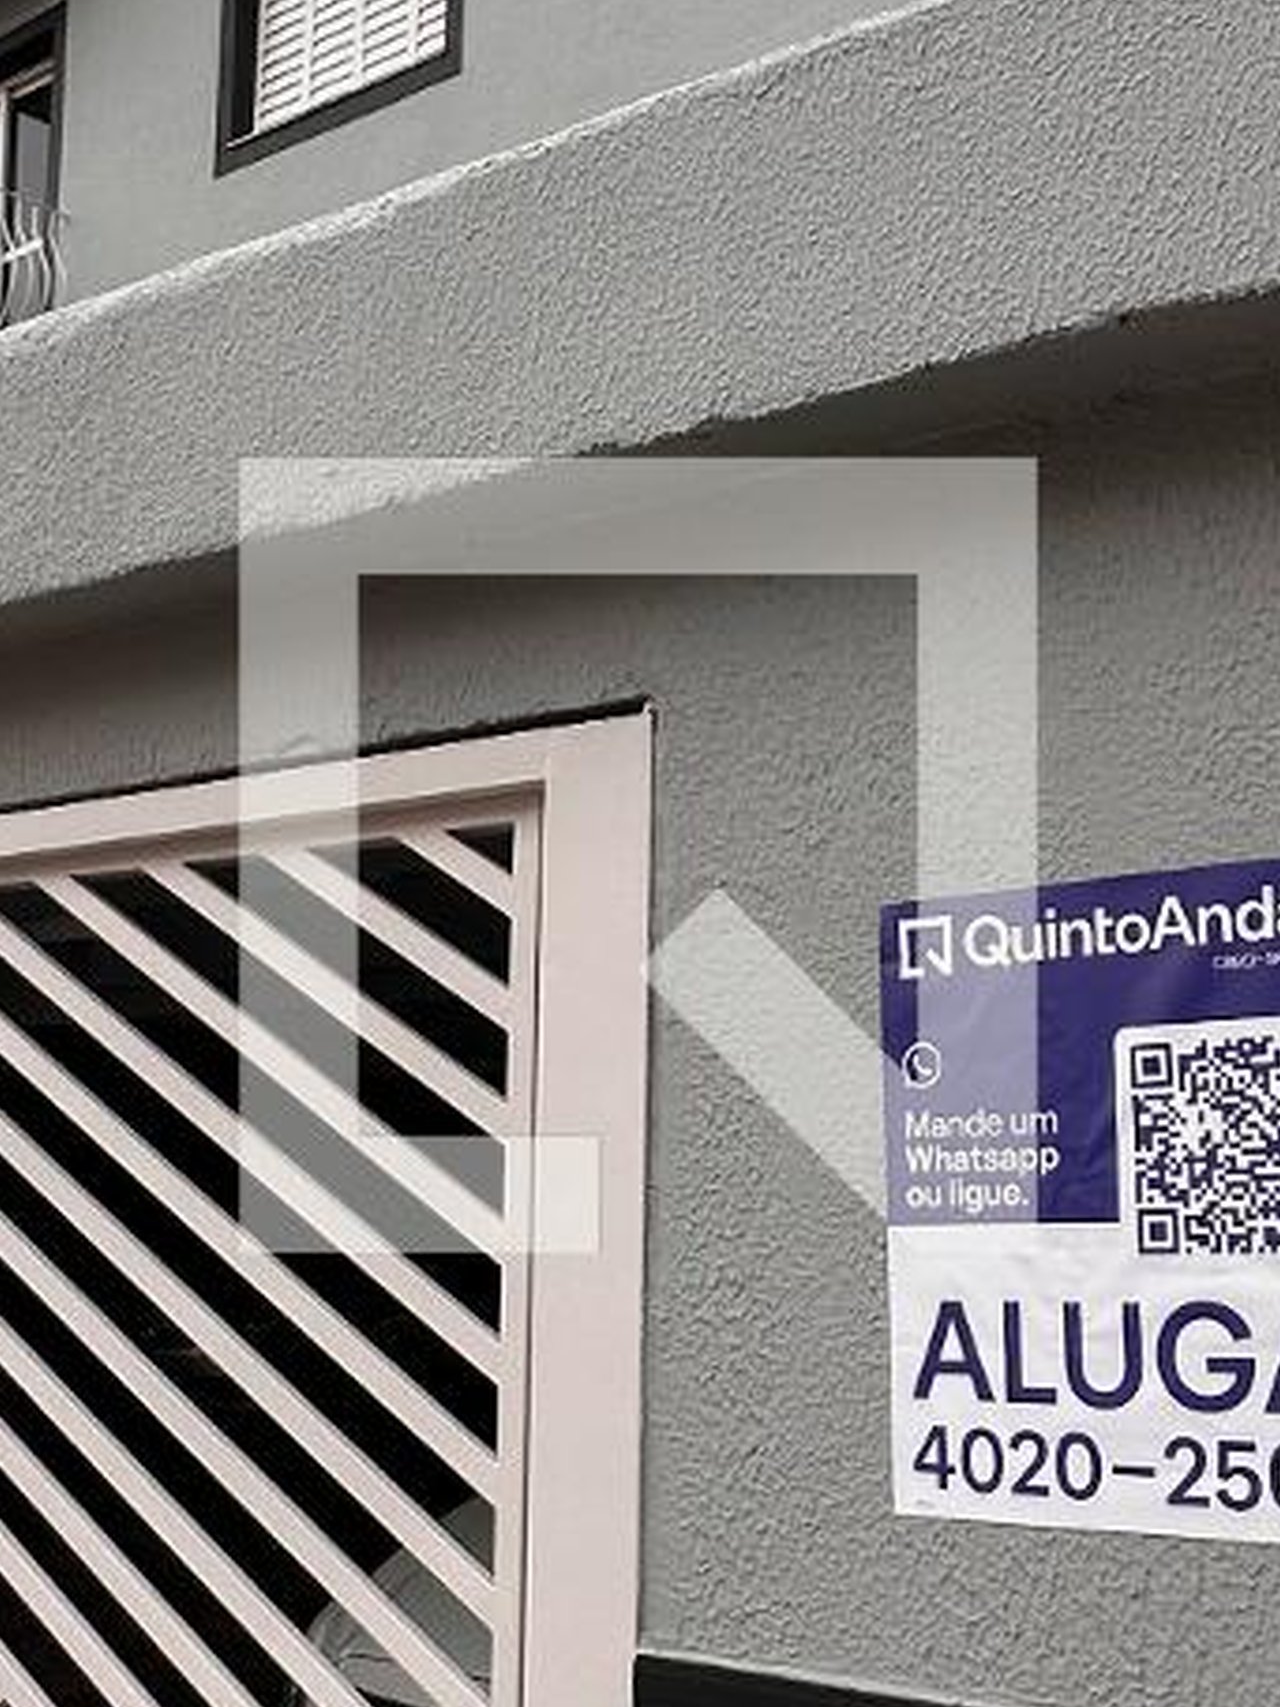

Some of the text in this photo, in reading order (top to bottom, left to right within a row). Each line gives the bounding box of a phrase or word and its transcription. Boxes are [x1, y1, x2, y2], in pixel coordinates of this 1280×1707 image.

[905, 1108, 1059, 1139] Mande um
[905, 1144, 1061, 1179] Whatsapp
[905, 1177, 1030, 1213] ou ligue.
